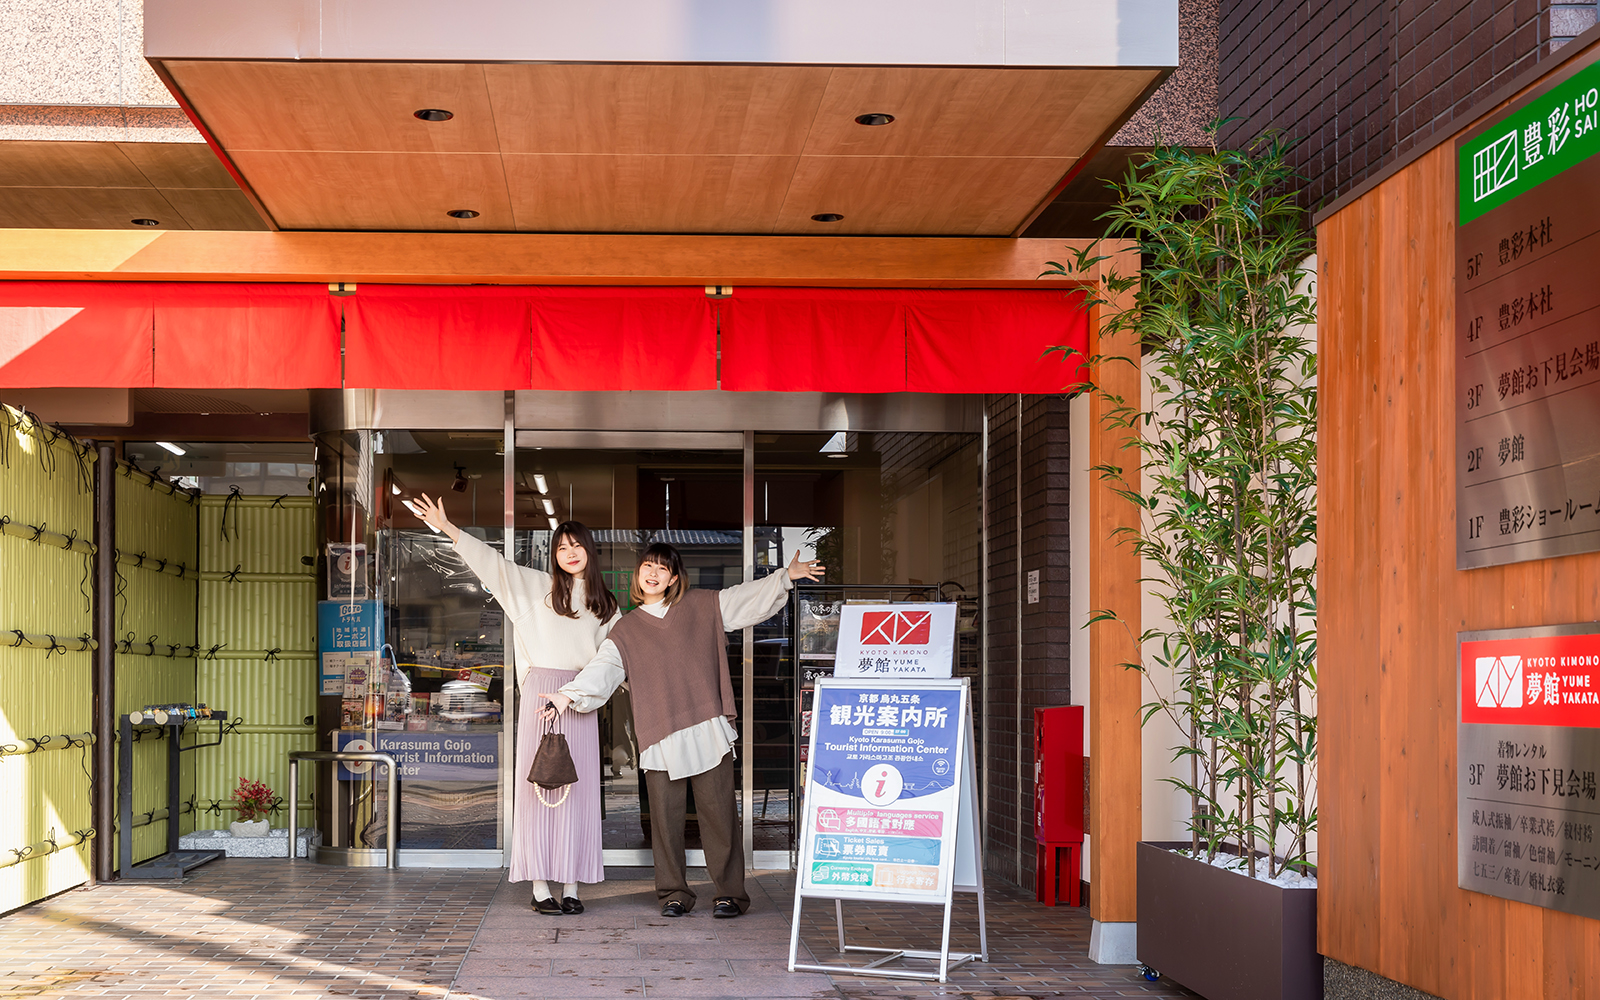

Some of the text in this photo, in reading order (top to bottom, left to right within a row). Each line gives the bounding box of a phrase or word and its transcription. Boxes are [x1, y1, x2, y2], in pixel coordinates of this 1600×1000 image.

[1575, 88, 1599, 116] HO
[1575, 110, 1597, 138] SAI
[1522, 102, 1571, 170] 豊彩
[1466, 216, 1553, 280] 5F 豊彩本社
[1466, 284, 1553, 342] 4F 豊彩本社
[1467, 341, 1600, 410] 3F 夢館お下見会場
[1467, 434, 1525, 473] 2F 夢館
[1468, 515, 1485, 540] 1F
[858, 657, 891, 673] 夢館
[1527, 655, 1600, 668] KYOTO KIMONO
[1526, 671, 1561, 706] 夢館
[1562, 675, 1590, 688] YUME
[858, 693, 921, 705] 京都 烏丸五条
[1562, 691, 1600, 704] YAKATA
[829, 704, 948, 729] 観光案内所
[380, 739, 472, 752] Karasuma Gojo
[824, 742, 949, 755] Tourist Information Center
[848, 736, 925, 746] Kyoto Karasuma Gojo
[1497, 740, 1547, 759] 着物レンタル
[391, 752, 495, 763] urist Information
[379, 765, 421, 776] Cnter
[1469, 763, 1596, 800] 3F 夢館お下見会場
[846, 809, 939, 820] Multiple languages service
